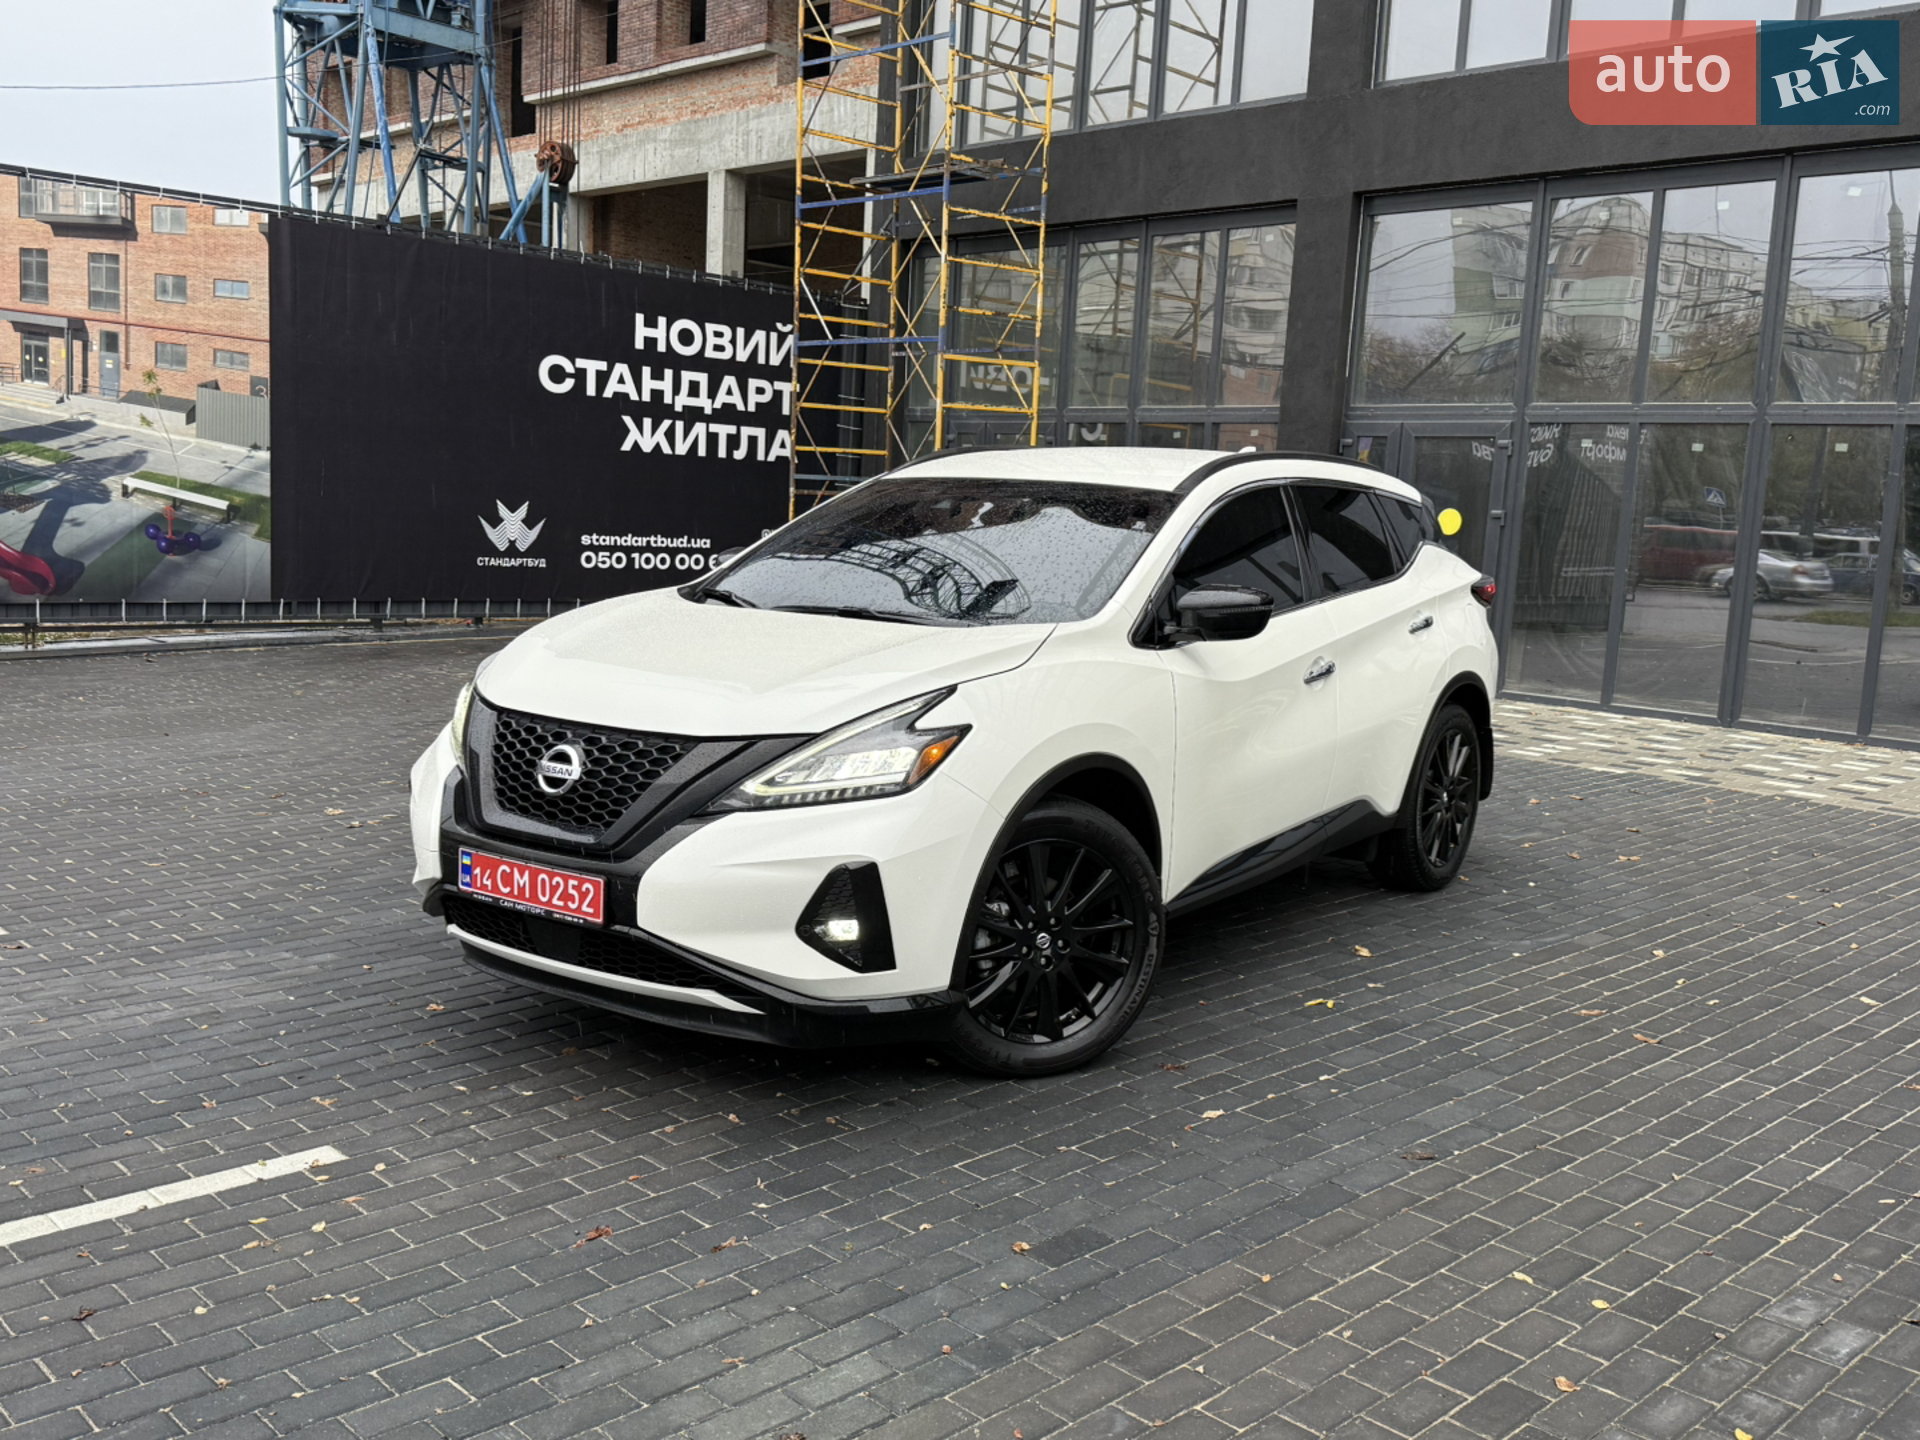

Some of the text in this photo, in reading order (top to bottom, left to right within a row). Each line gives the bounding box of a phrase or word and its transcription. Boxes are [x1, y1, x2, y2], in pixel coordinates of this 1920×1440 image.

[634, 312, 794, 368] НОВИЙ
[538, 354, 800, 416] СТАНДАРТ
[620, 414, 798, 463] ЖИТЛА
[477, 556, 547, 569] СТАНДАРТБУД
[580, 532, 711, 549] standartbud.ua
[580, 551, 627, 569] 050
[632, 553, 671, 570] 100
[675, 553, 705, 570] 00
[473, 864, 595, 914] 14 CM 0252
